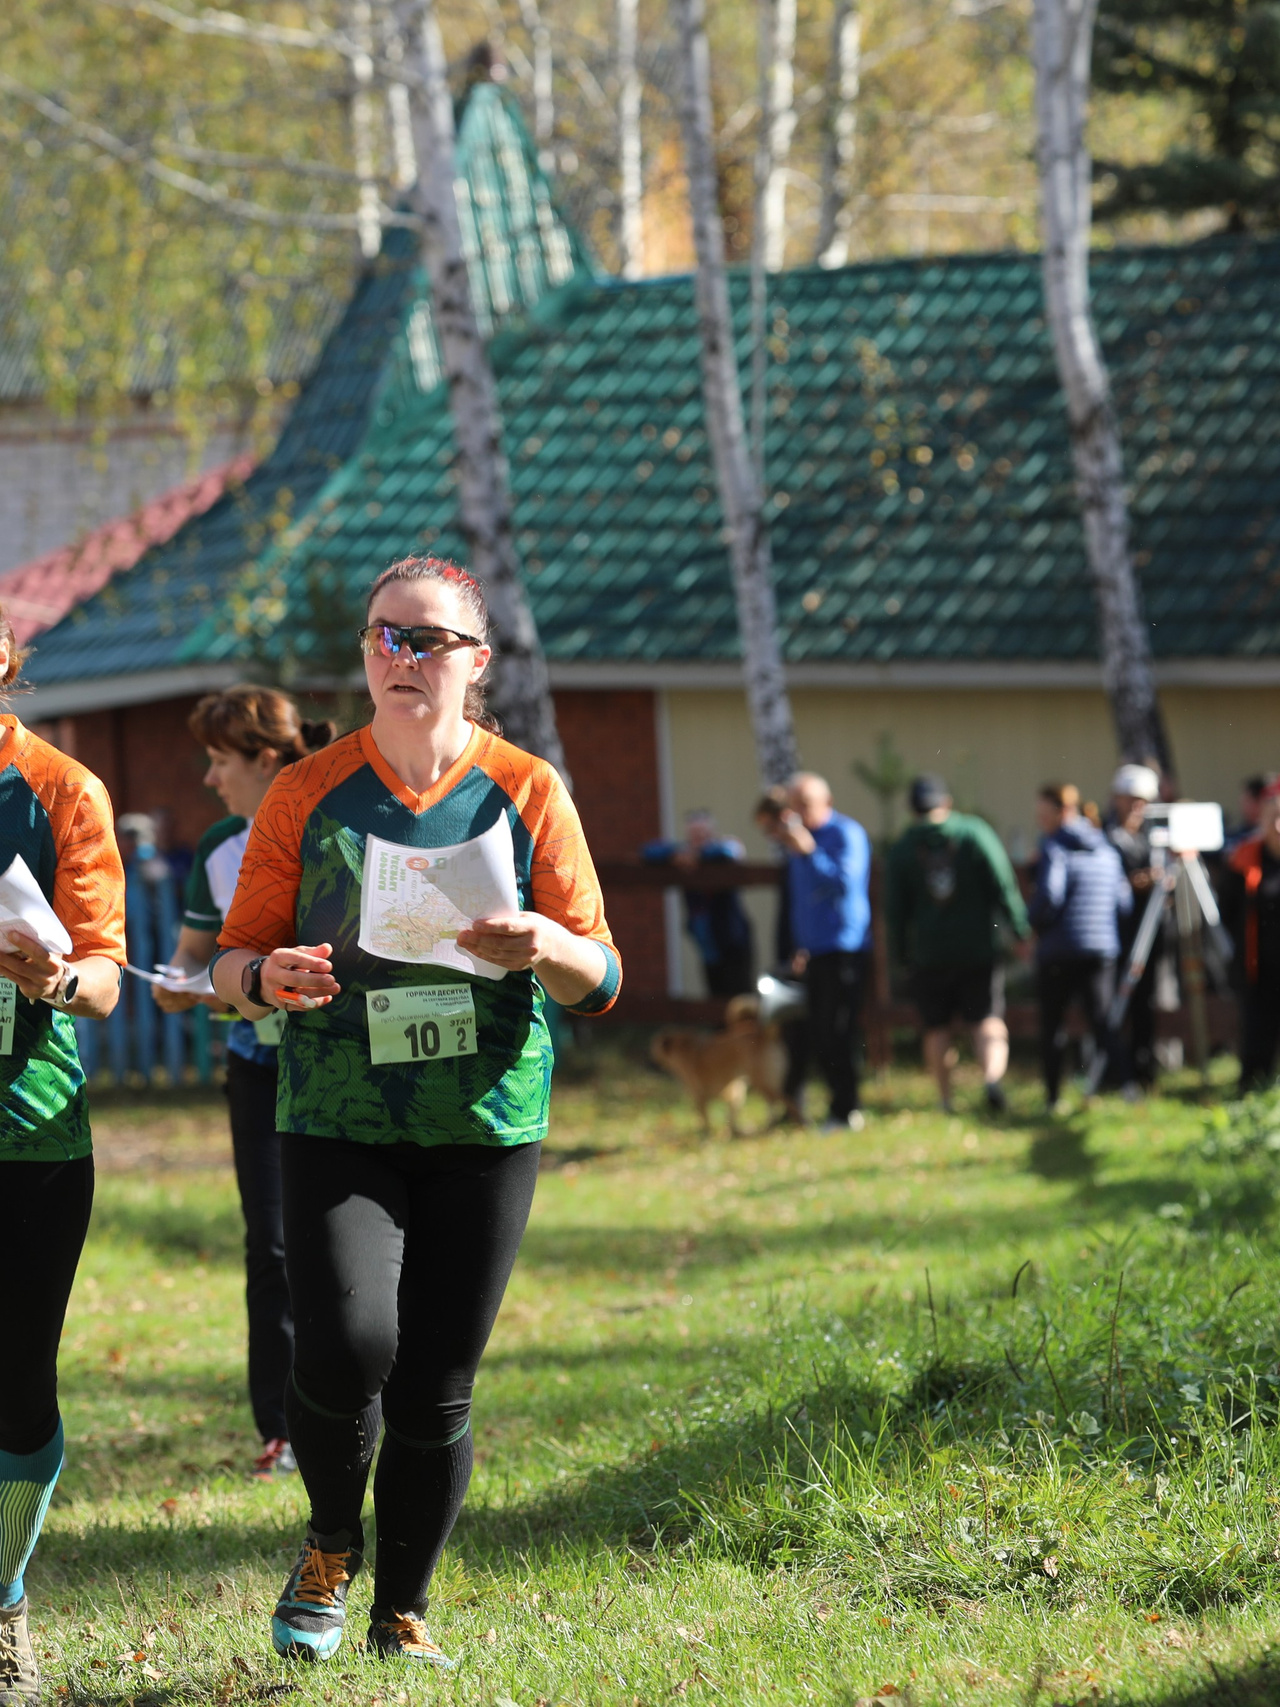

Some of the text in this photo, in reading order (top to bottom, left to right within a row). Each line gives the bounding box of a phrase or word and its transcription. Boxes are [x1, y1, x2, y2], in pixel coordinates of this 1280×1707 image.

[406, 988, 468, 998] ГОРЯЧАЯ ДЕСЯТКА
[449, 1017, 472, 1027] ЭТАП
[404, 1020, 440, 1058] 10
[456, 1027, 467, 1052] 2
